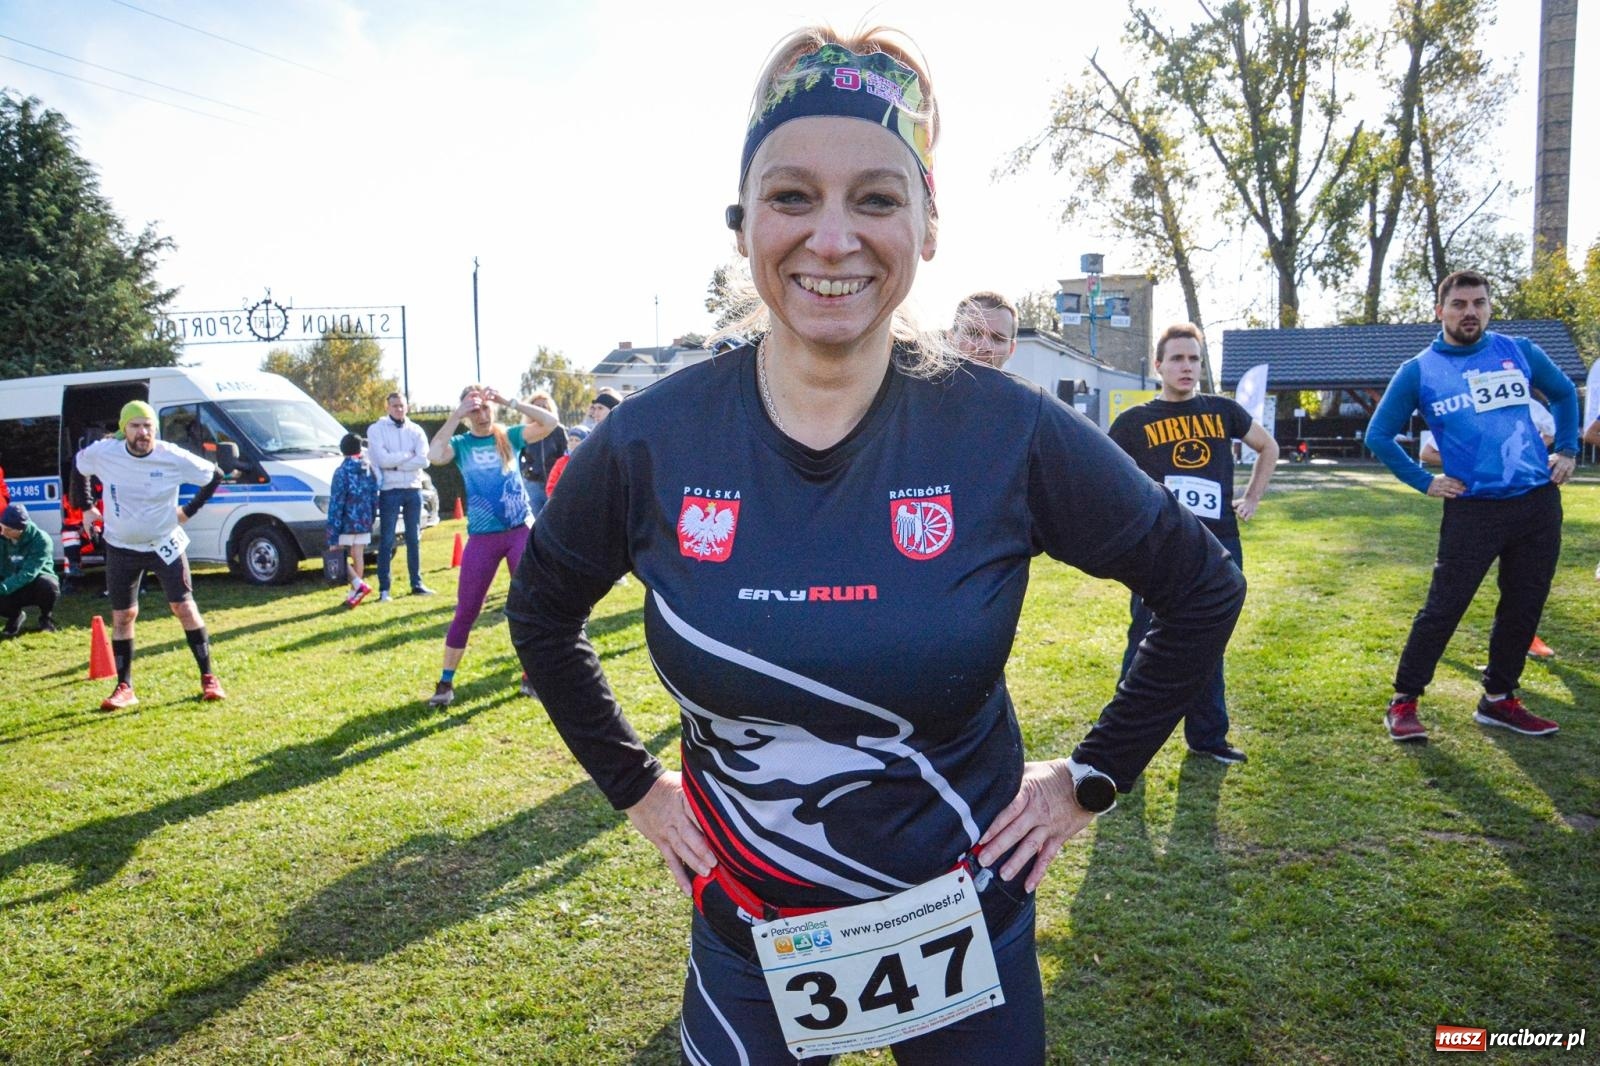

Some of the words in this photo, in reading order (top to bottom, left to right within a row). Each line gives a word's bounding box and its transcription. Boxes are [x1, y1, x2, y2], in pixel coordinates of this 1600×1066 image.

[1475, 381, 1526, 404] 349
[1143, 413, 1226, 449] NIRVANA
[23, 485, 40, 496] 985
[683, 486, 742, 500] POLSKA
[889, 484, 952, 500] RACIBÓRZ
[840, 888, 966, 939] www.personalbest.pl
[770, 920, 829, 938] PersonalBest
[785, 925, 975, 1031] 347
